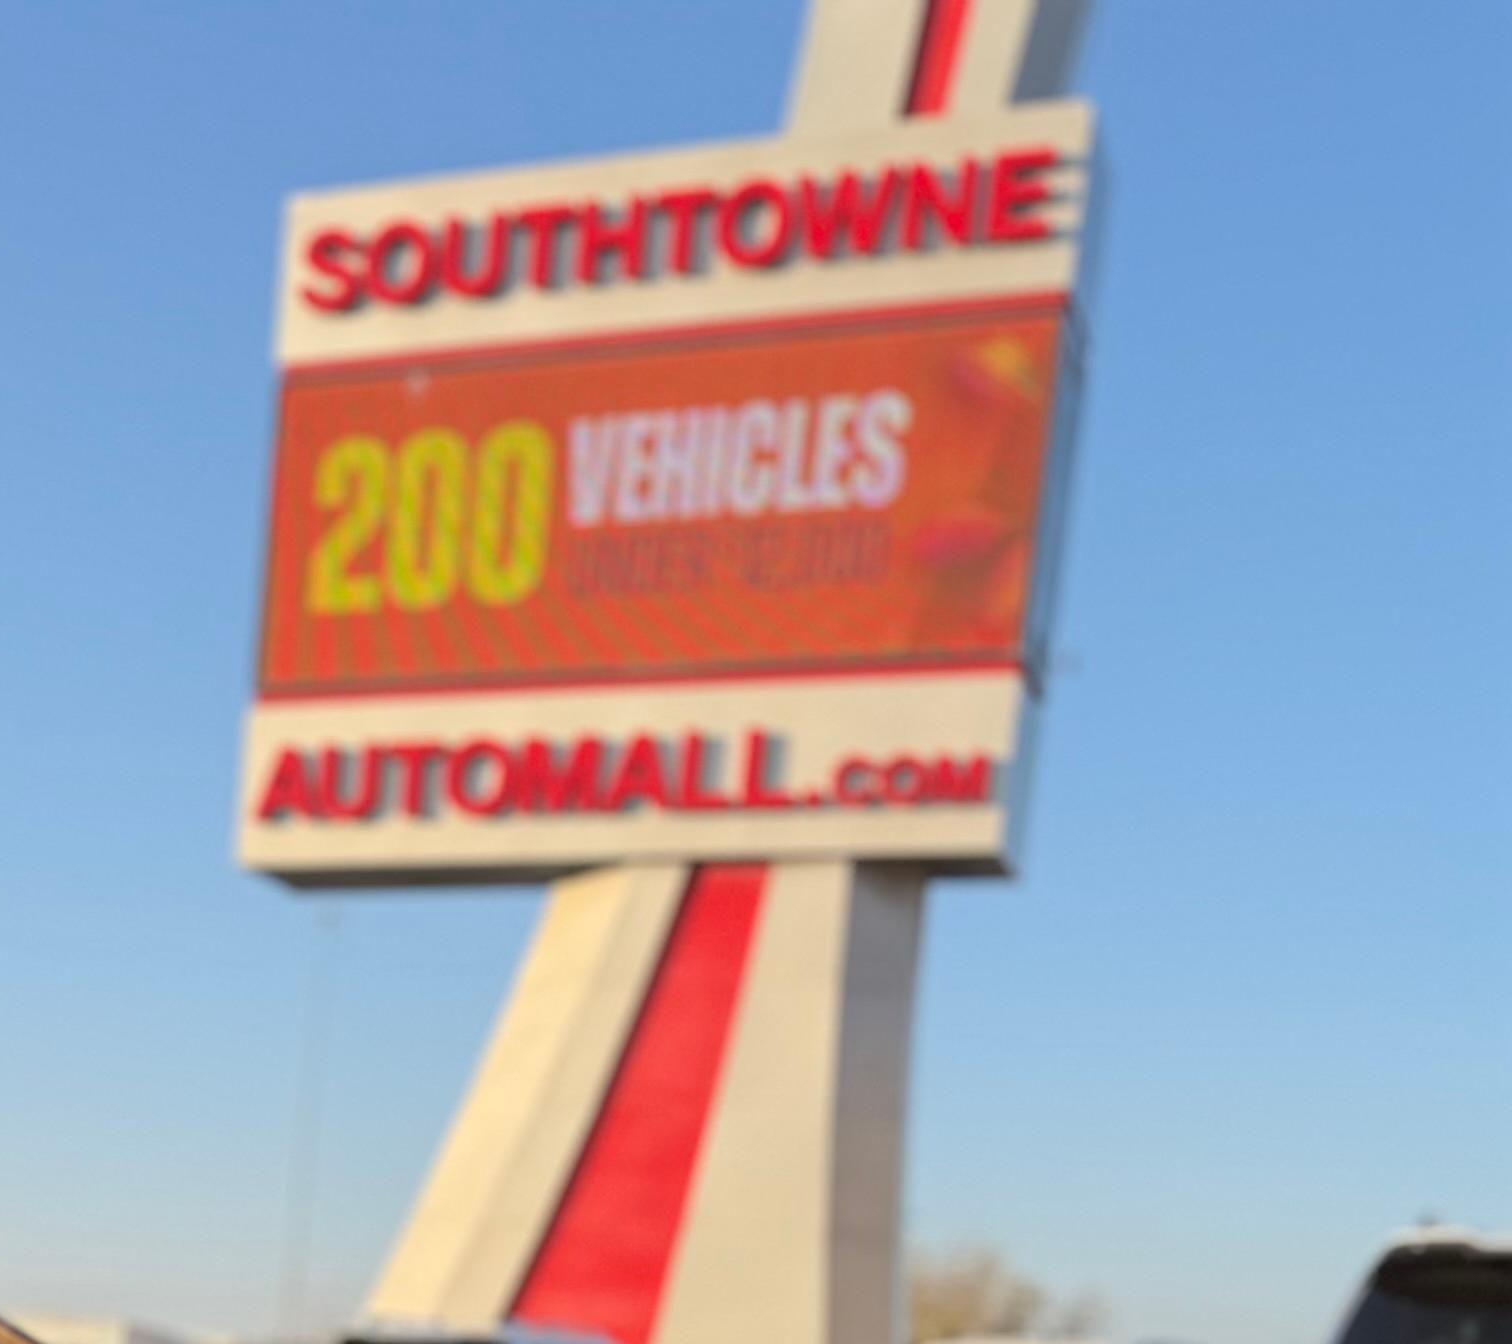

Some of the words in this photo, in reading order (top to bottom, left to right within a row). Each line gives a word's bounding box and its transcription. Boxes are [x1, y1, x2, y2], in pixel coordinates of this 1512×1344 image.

[301, 146, 1059, 315] SOUTHTOWNE
[310, 422, 553, 615] 200
[566, 388, 914, 528] VEHICLES
